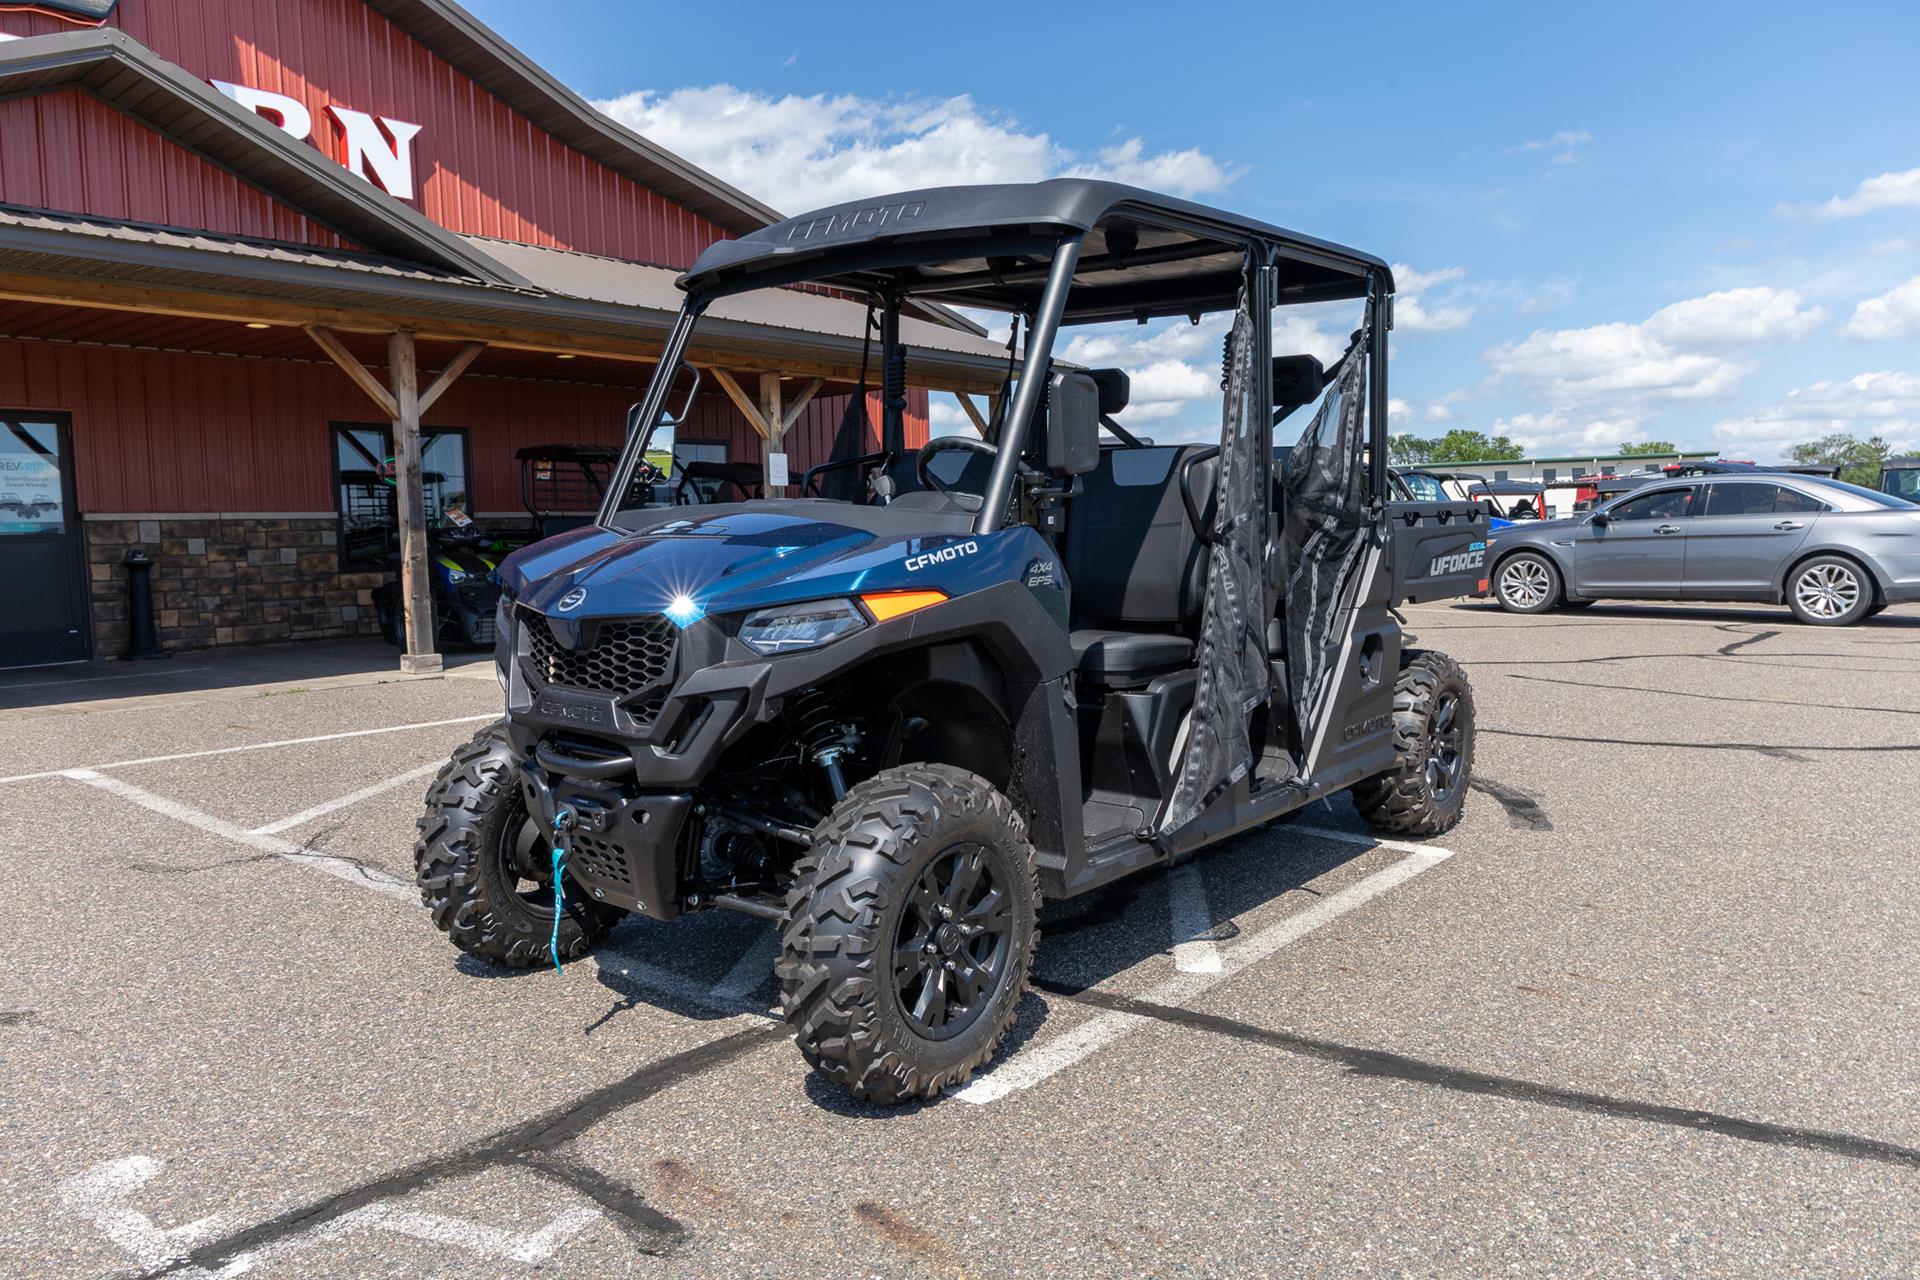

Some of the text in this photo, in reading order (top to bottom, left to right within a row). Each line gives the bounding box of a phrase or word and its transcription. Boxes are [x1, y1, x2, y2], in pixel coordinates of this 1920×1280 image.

[787, 200, 927, 241] CFMOTO
[904, 541, 979, 572] CFMOTO
[1430, 550, 1485, 577] UFORCE
[1028, 575, 1053, 587] EPS
[540, 701, 604, 723] CFMOTO
[1343, 712, 1389, 742] CFMOTO
